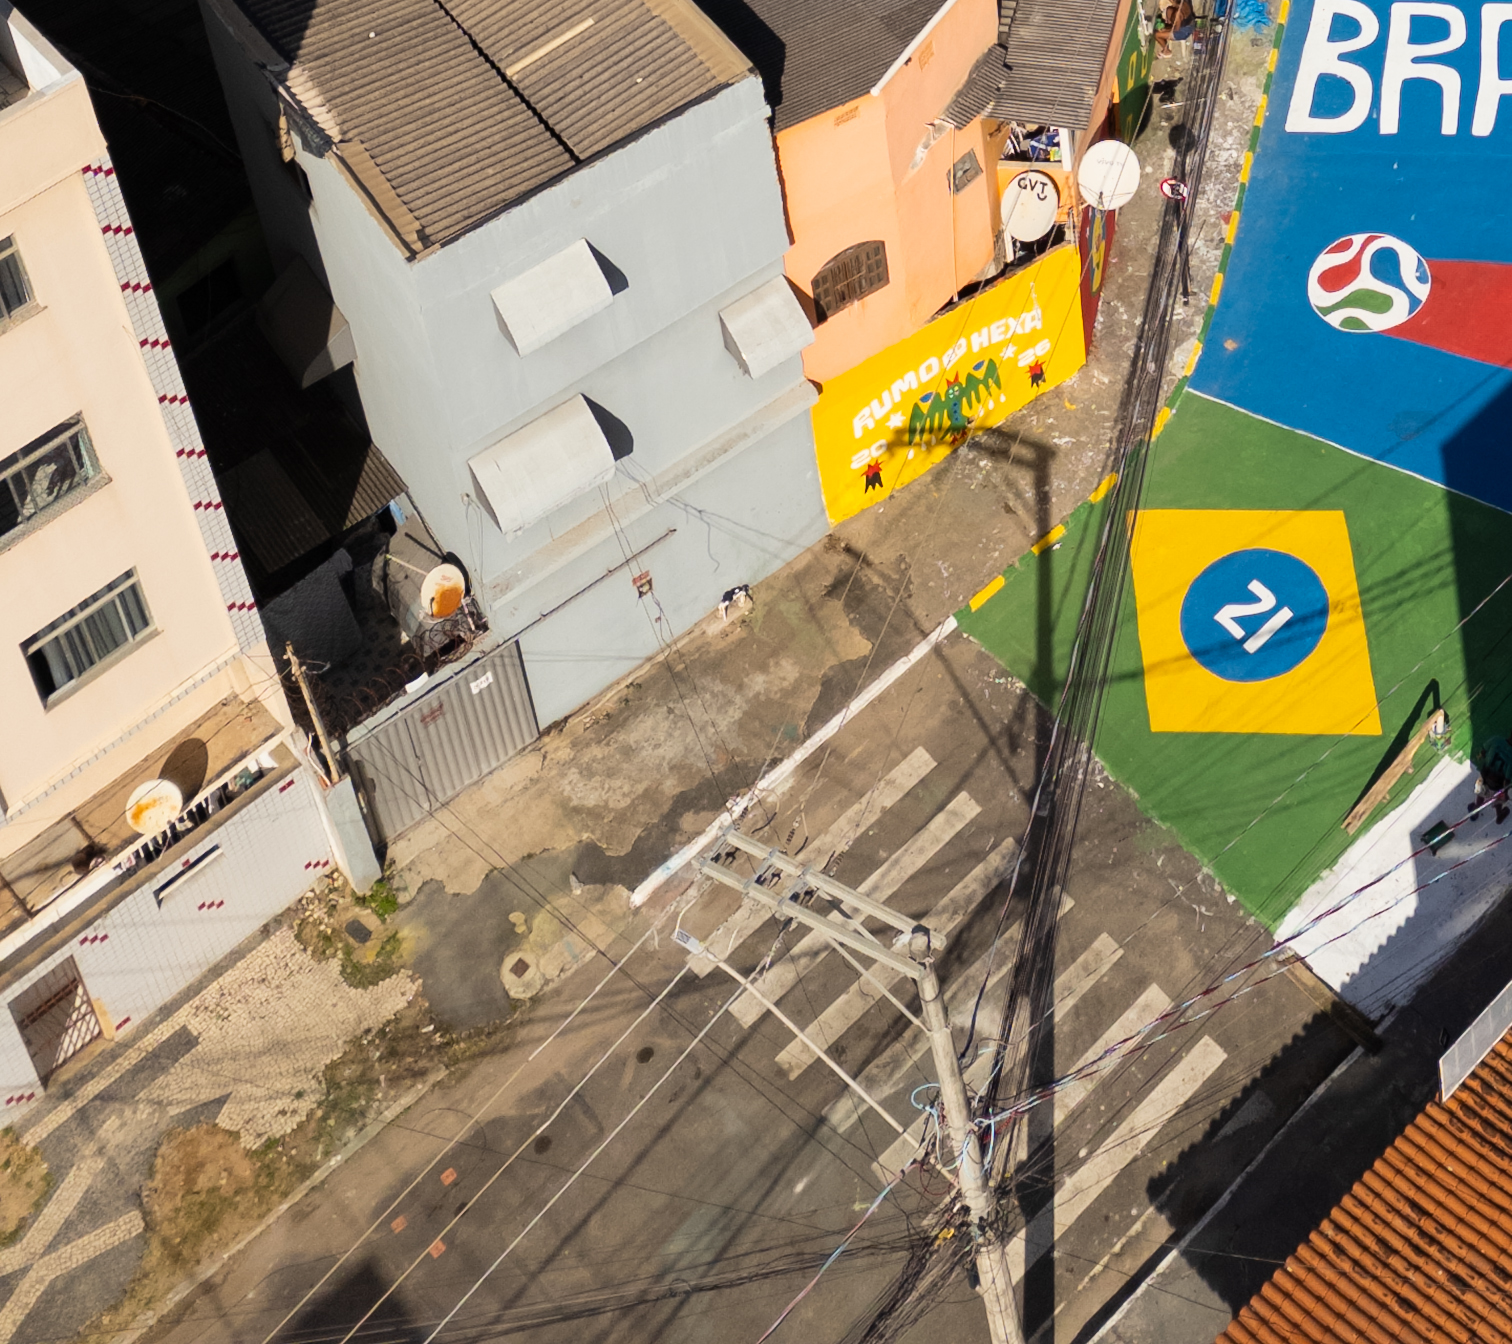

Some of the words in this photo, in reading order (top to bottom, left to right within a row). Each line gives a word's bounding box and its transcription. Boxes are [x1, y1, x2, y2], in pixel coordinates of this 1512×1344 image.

[1017, 177, 1048, 194] GVT
[850, 439, 888, 470] 20
[1017, 339, 1051, 368] 26
[852, 356, 941, 439] RUMO
[970, 308, 1042, 353] HEXA
